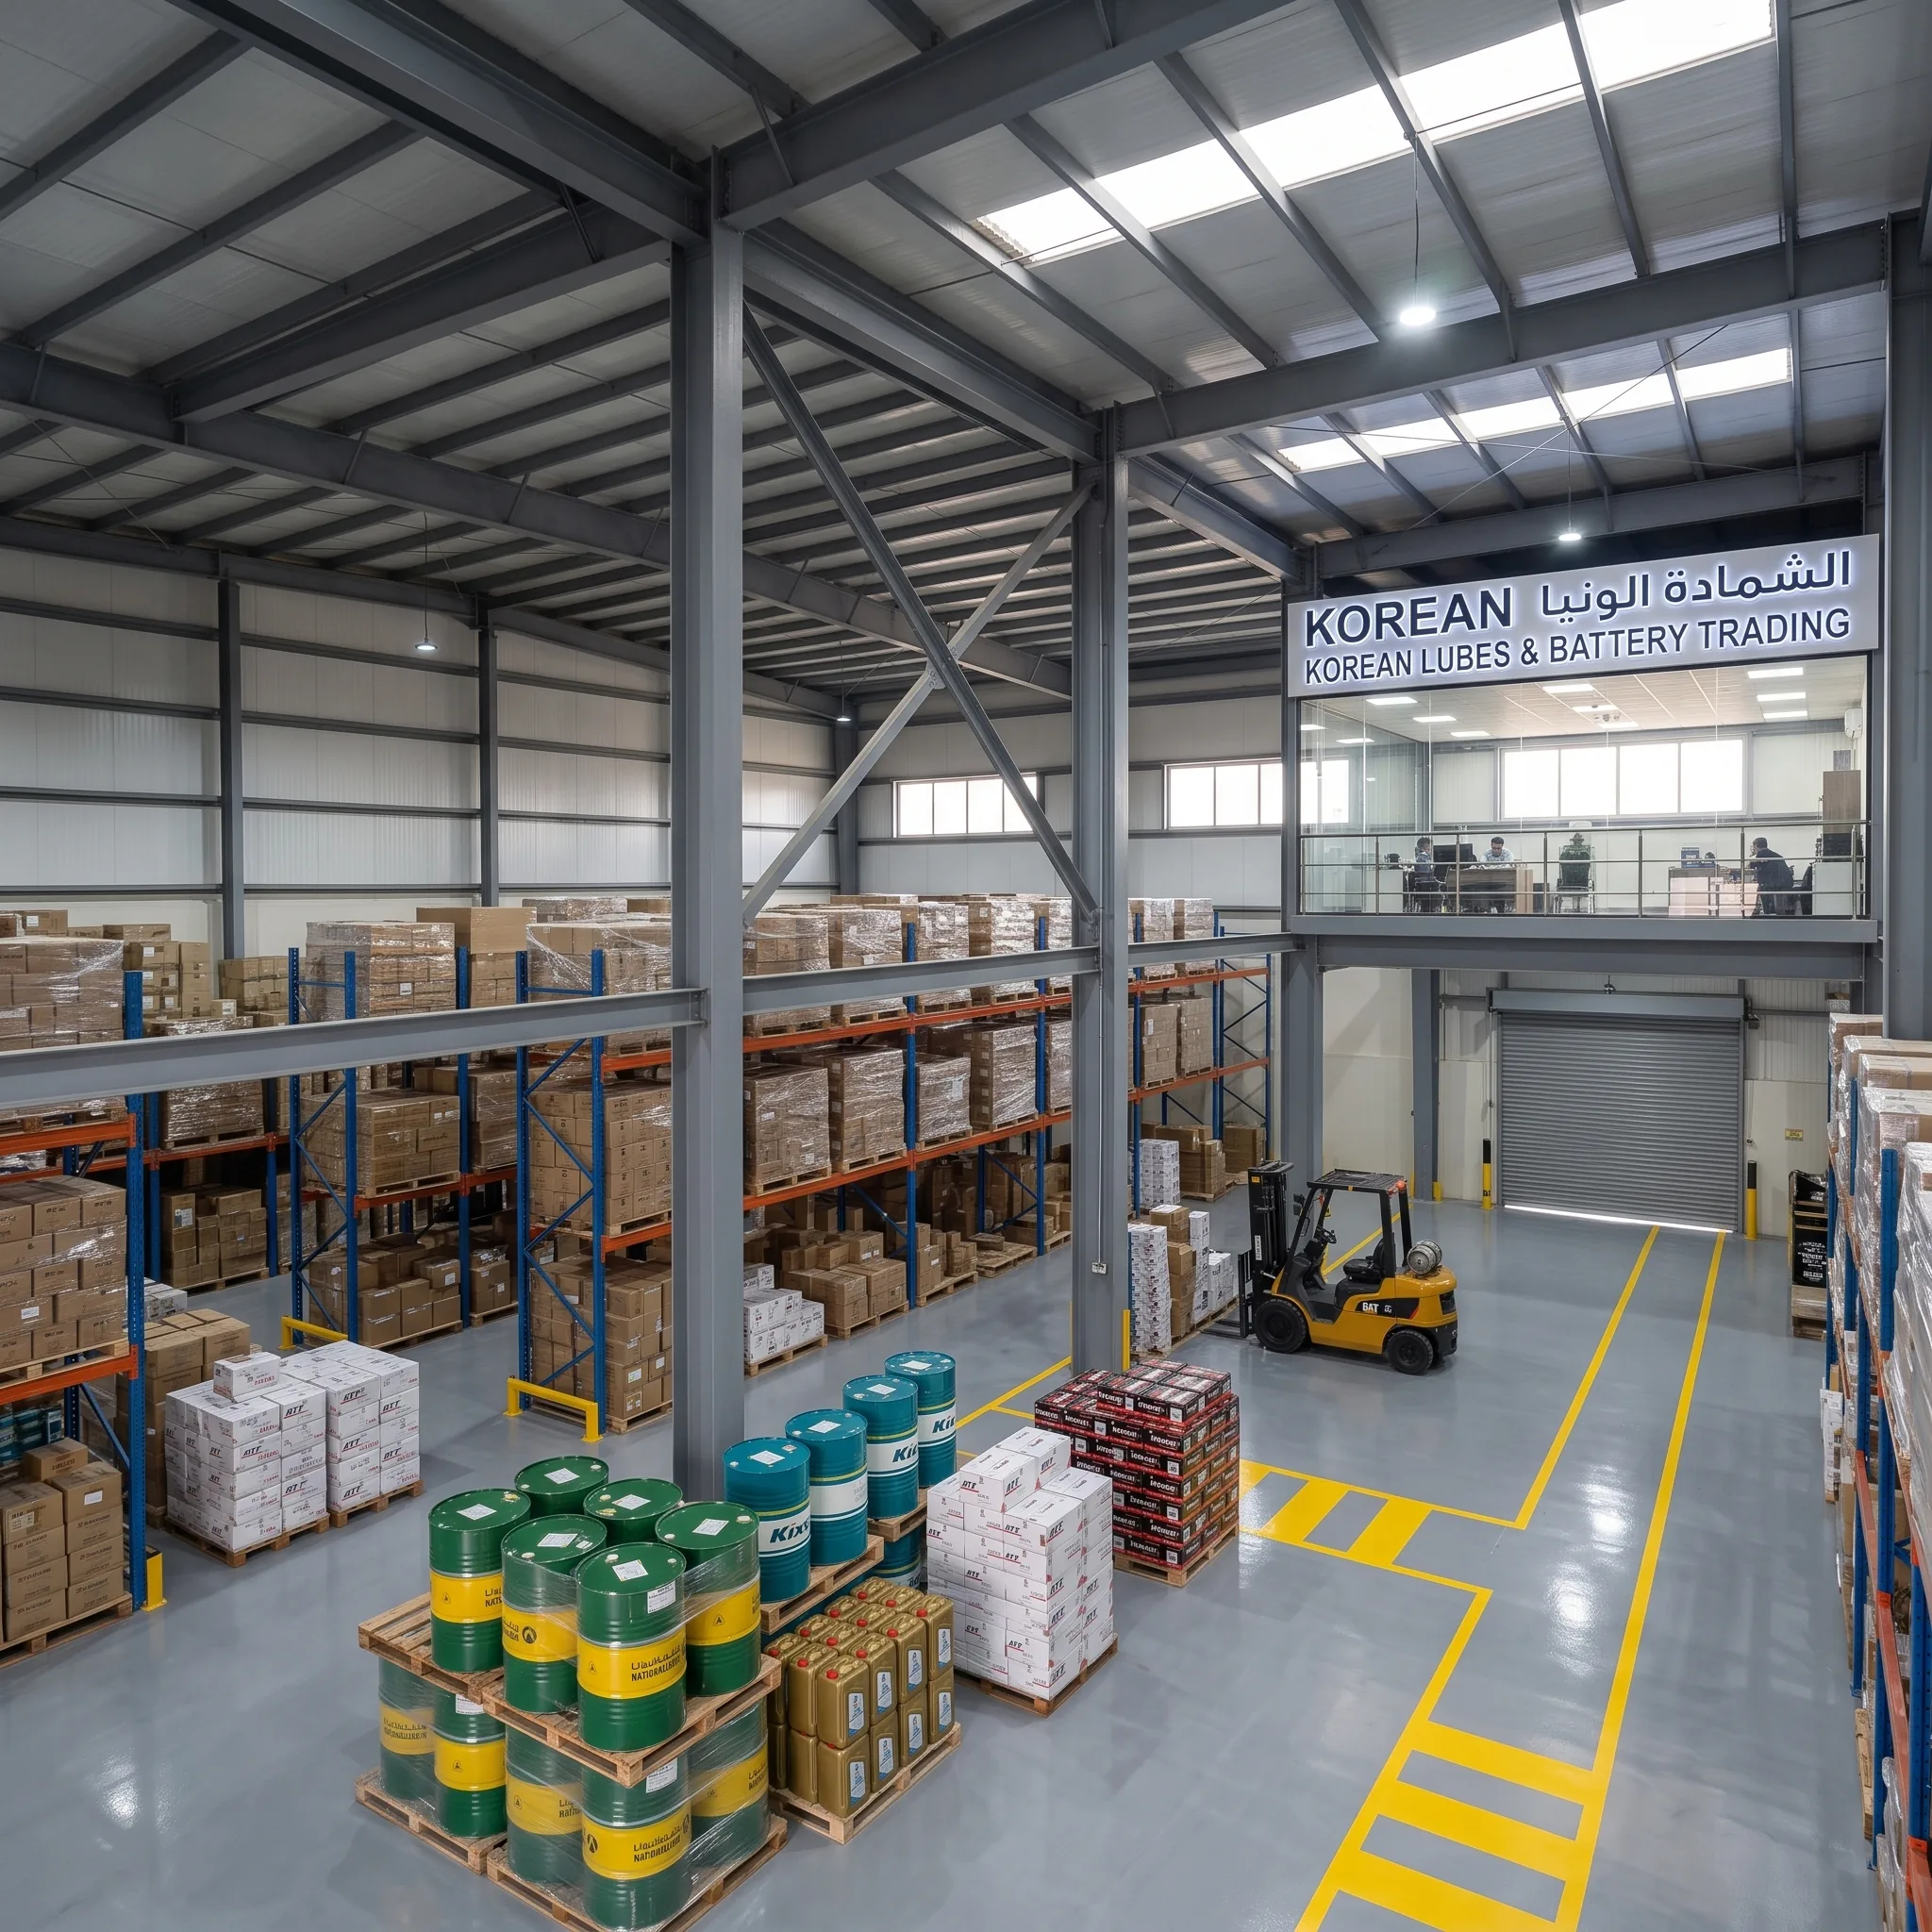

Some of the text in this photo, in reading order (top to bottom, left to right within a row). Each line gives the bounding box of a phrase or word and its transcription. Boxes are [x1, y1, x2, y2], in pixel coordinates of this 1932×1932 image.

[1306, 587, 1511, 647] KOREAN
[1306, 608, 1849, 684] KOREAN LUBES & BATTERY TRADING
